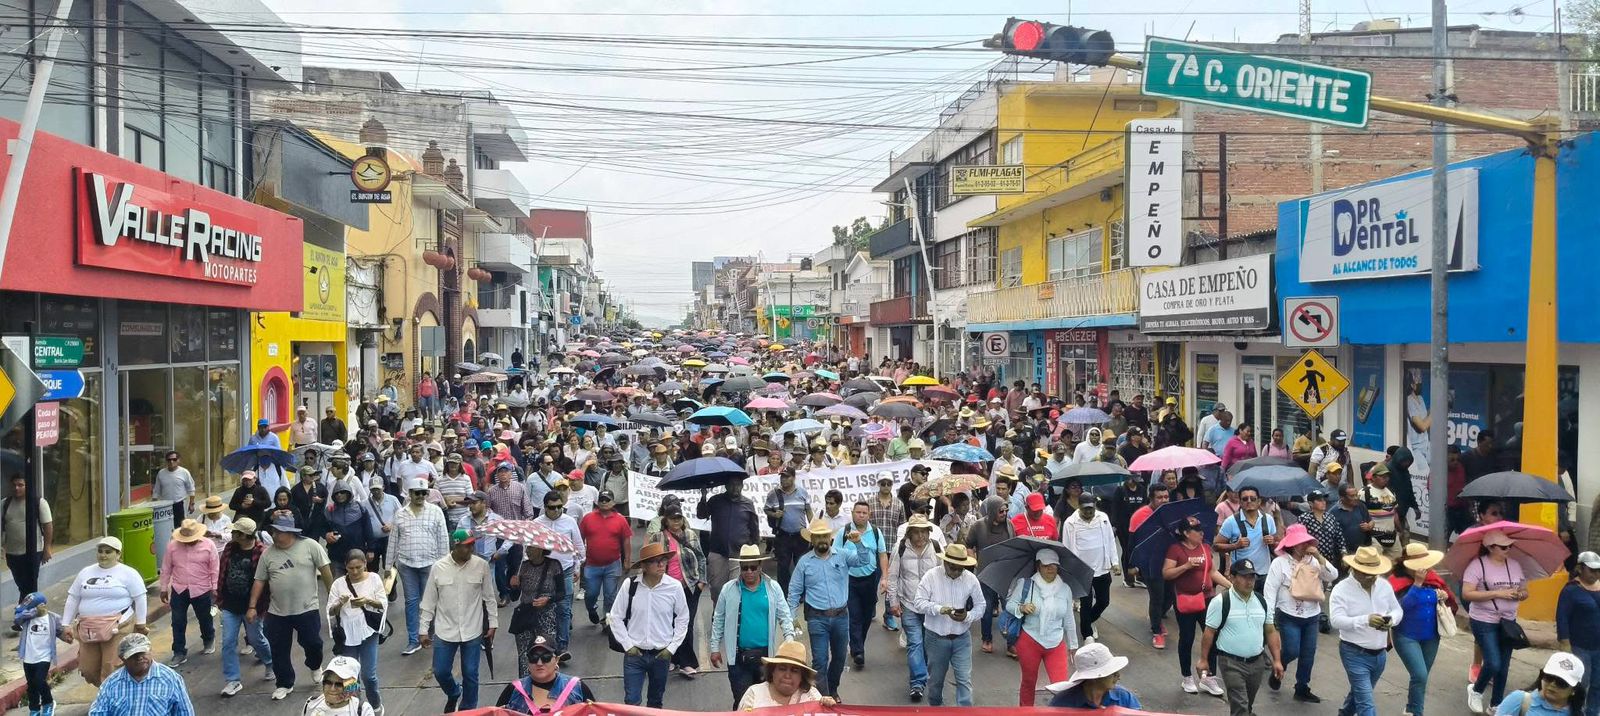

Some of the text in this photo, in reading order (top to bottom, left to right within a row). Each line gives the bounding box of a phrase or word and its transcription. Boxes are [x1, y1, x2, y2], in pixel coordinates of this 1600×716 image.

[1204, 59, 1228, 93] C.
[1236, 64, 1350, 113] ORIENTE
[1136, 125, 1176, 134] Casa de
[968, 168, 1022, 177] FUMI-PLAGAS
[1148, 140, 1164, 259] EMPEÑO
[204, 262, 256, 284] MOTOPARTES
[1332, 256, 1418, 274] AL ALCANCE DE TODOS
[1146, 266, 1258, 300] CASA DE EMPEÑO
[1164, 296, 1234, 310] COMPRA DE ORO Y PLATA
[34, 346, 64, 356] CENTRAL
[802, 478, 824, 490] LEY
[830, 476, 854, 490] DEL
